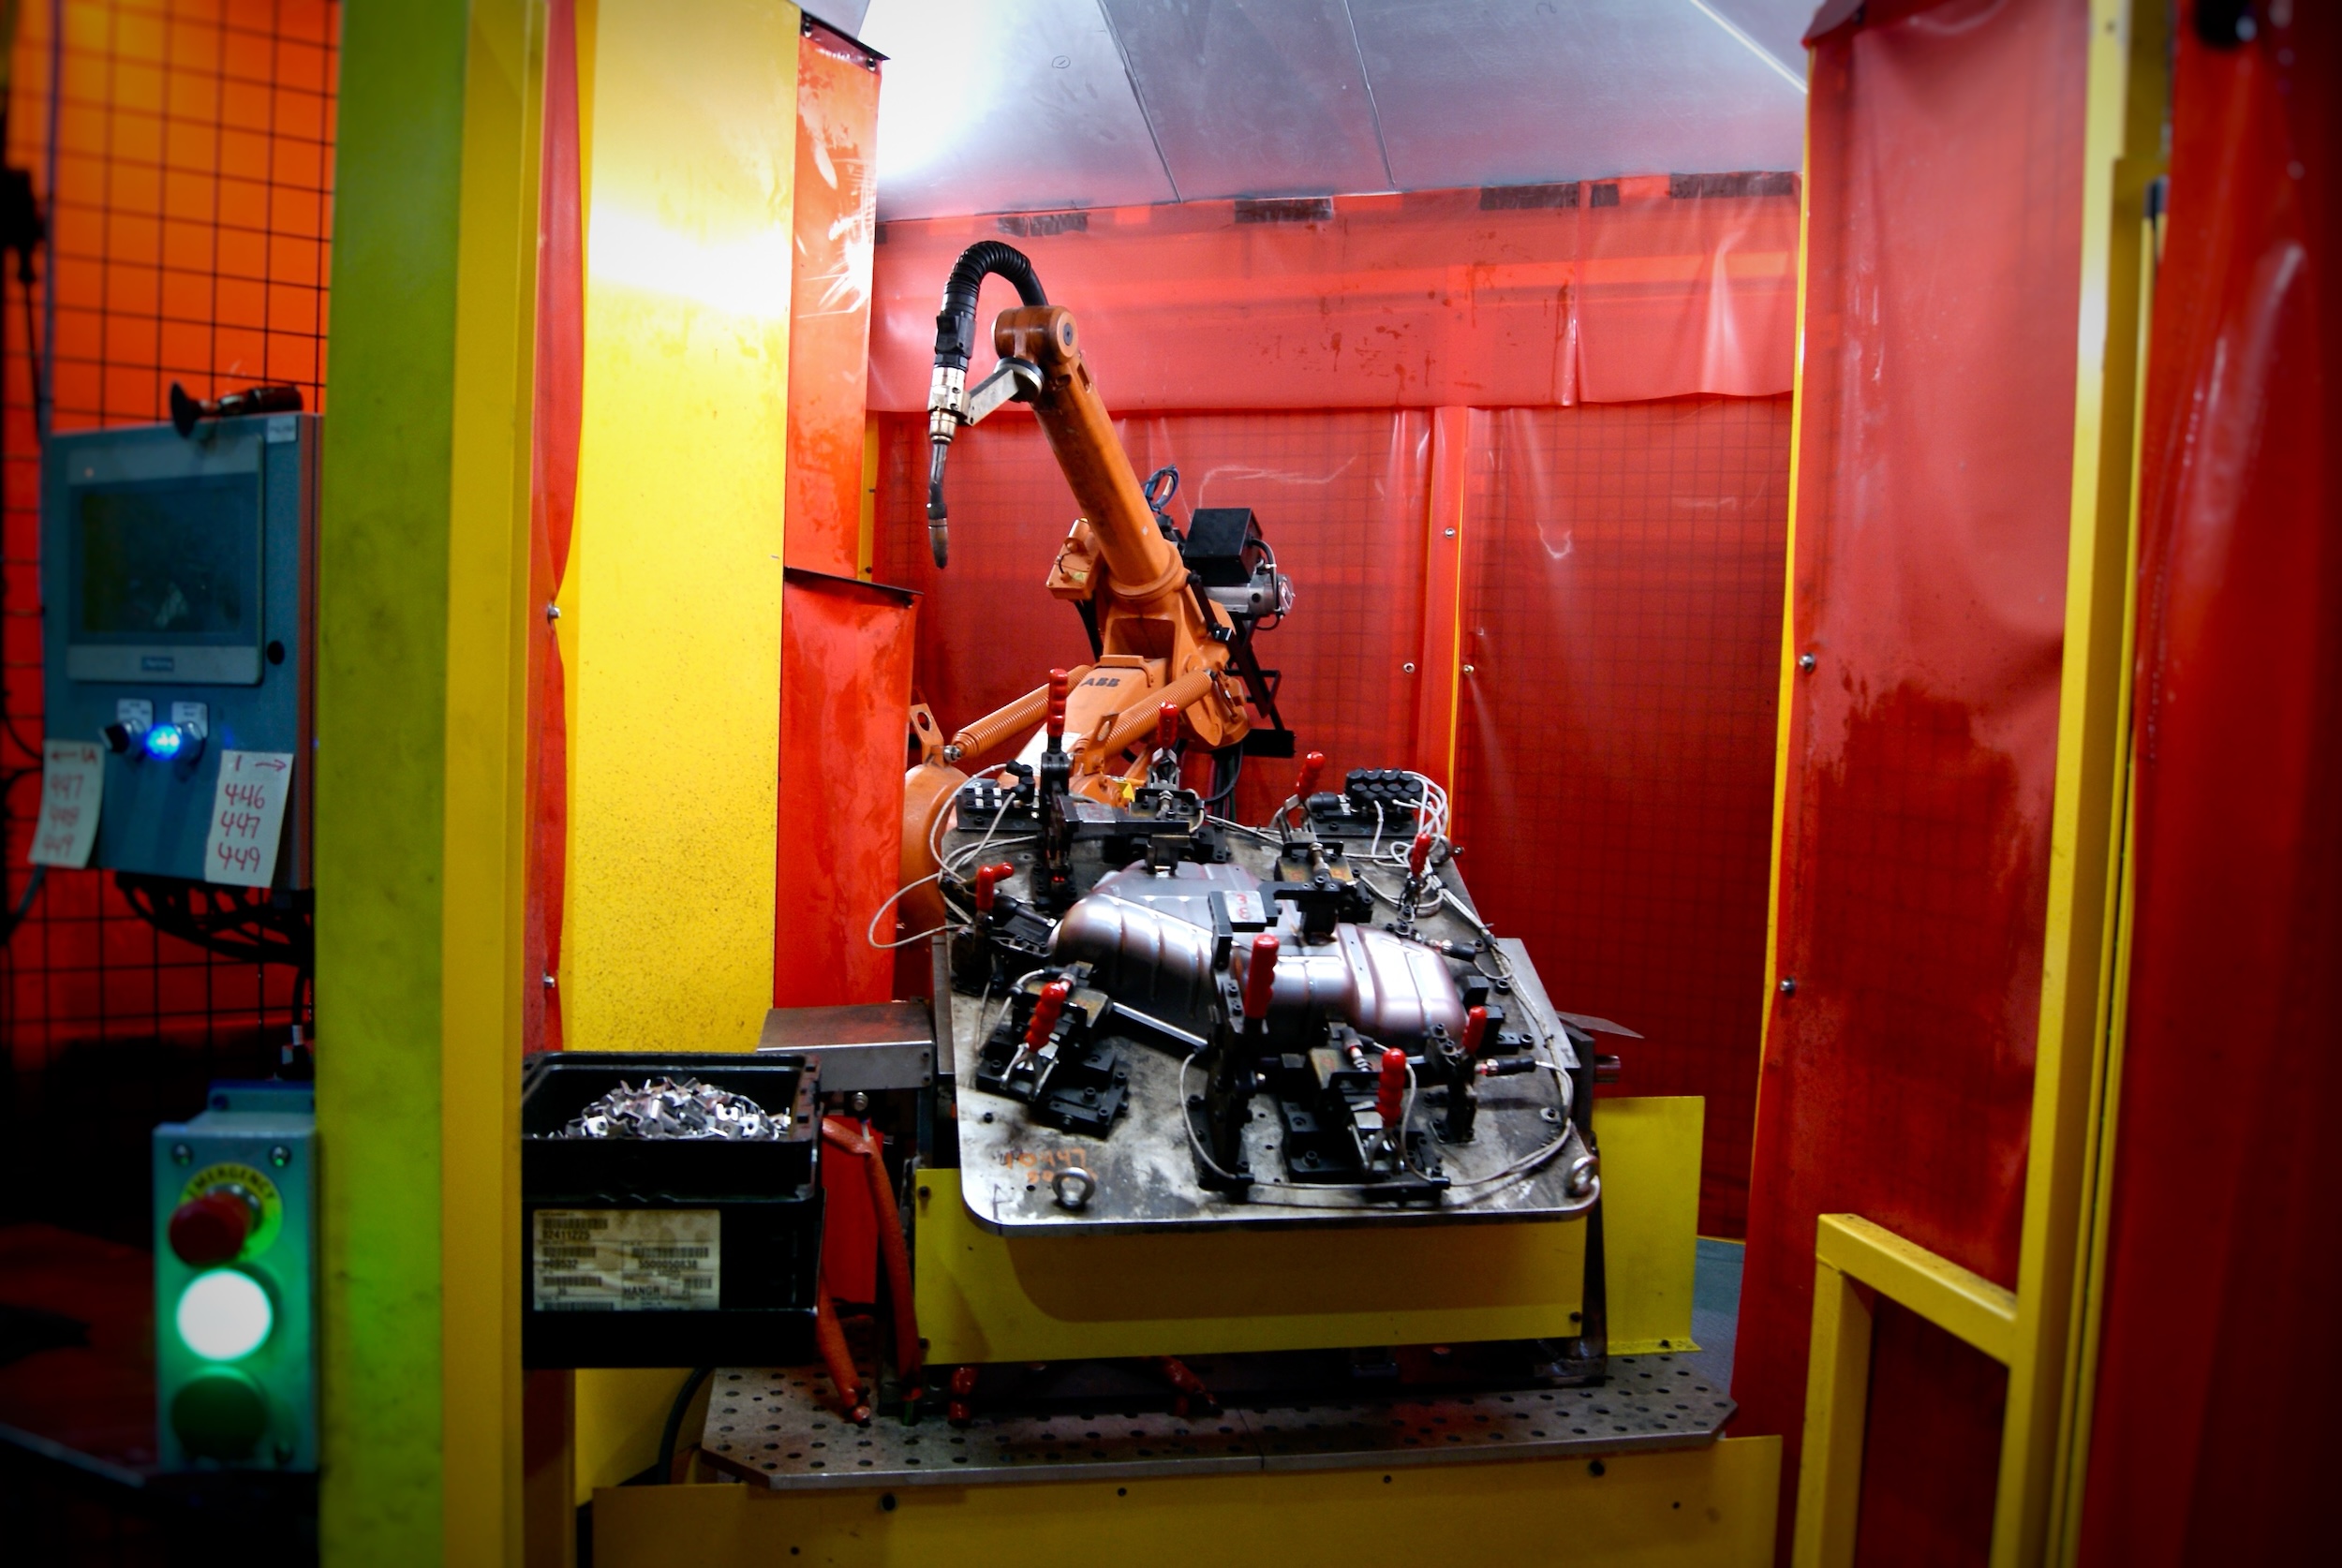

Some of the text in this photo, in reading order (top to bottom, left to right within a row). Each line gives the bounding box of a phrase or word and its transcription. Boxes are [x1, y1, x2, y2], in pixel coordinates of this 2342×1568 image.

[1080, 677, 1120, 688] ABB
[50, 773, 84, 800] 447
[224, 782, 265, 809] 446
[219, 810, 261, 839] 447
[217, 842, 261, 873] 449
